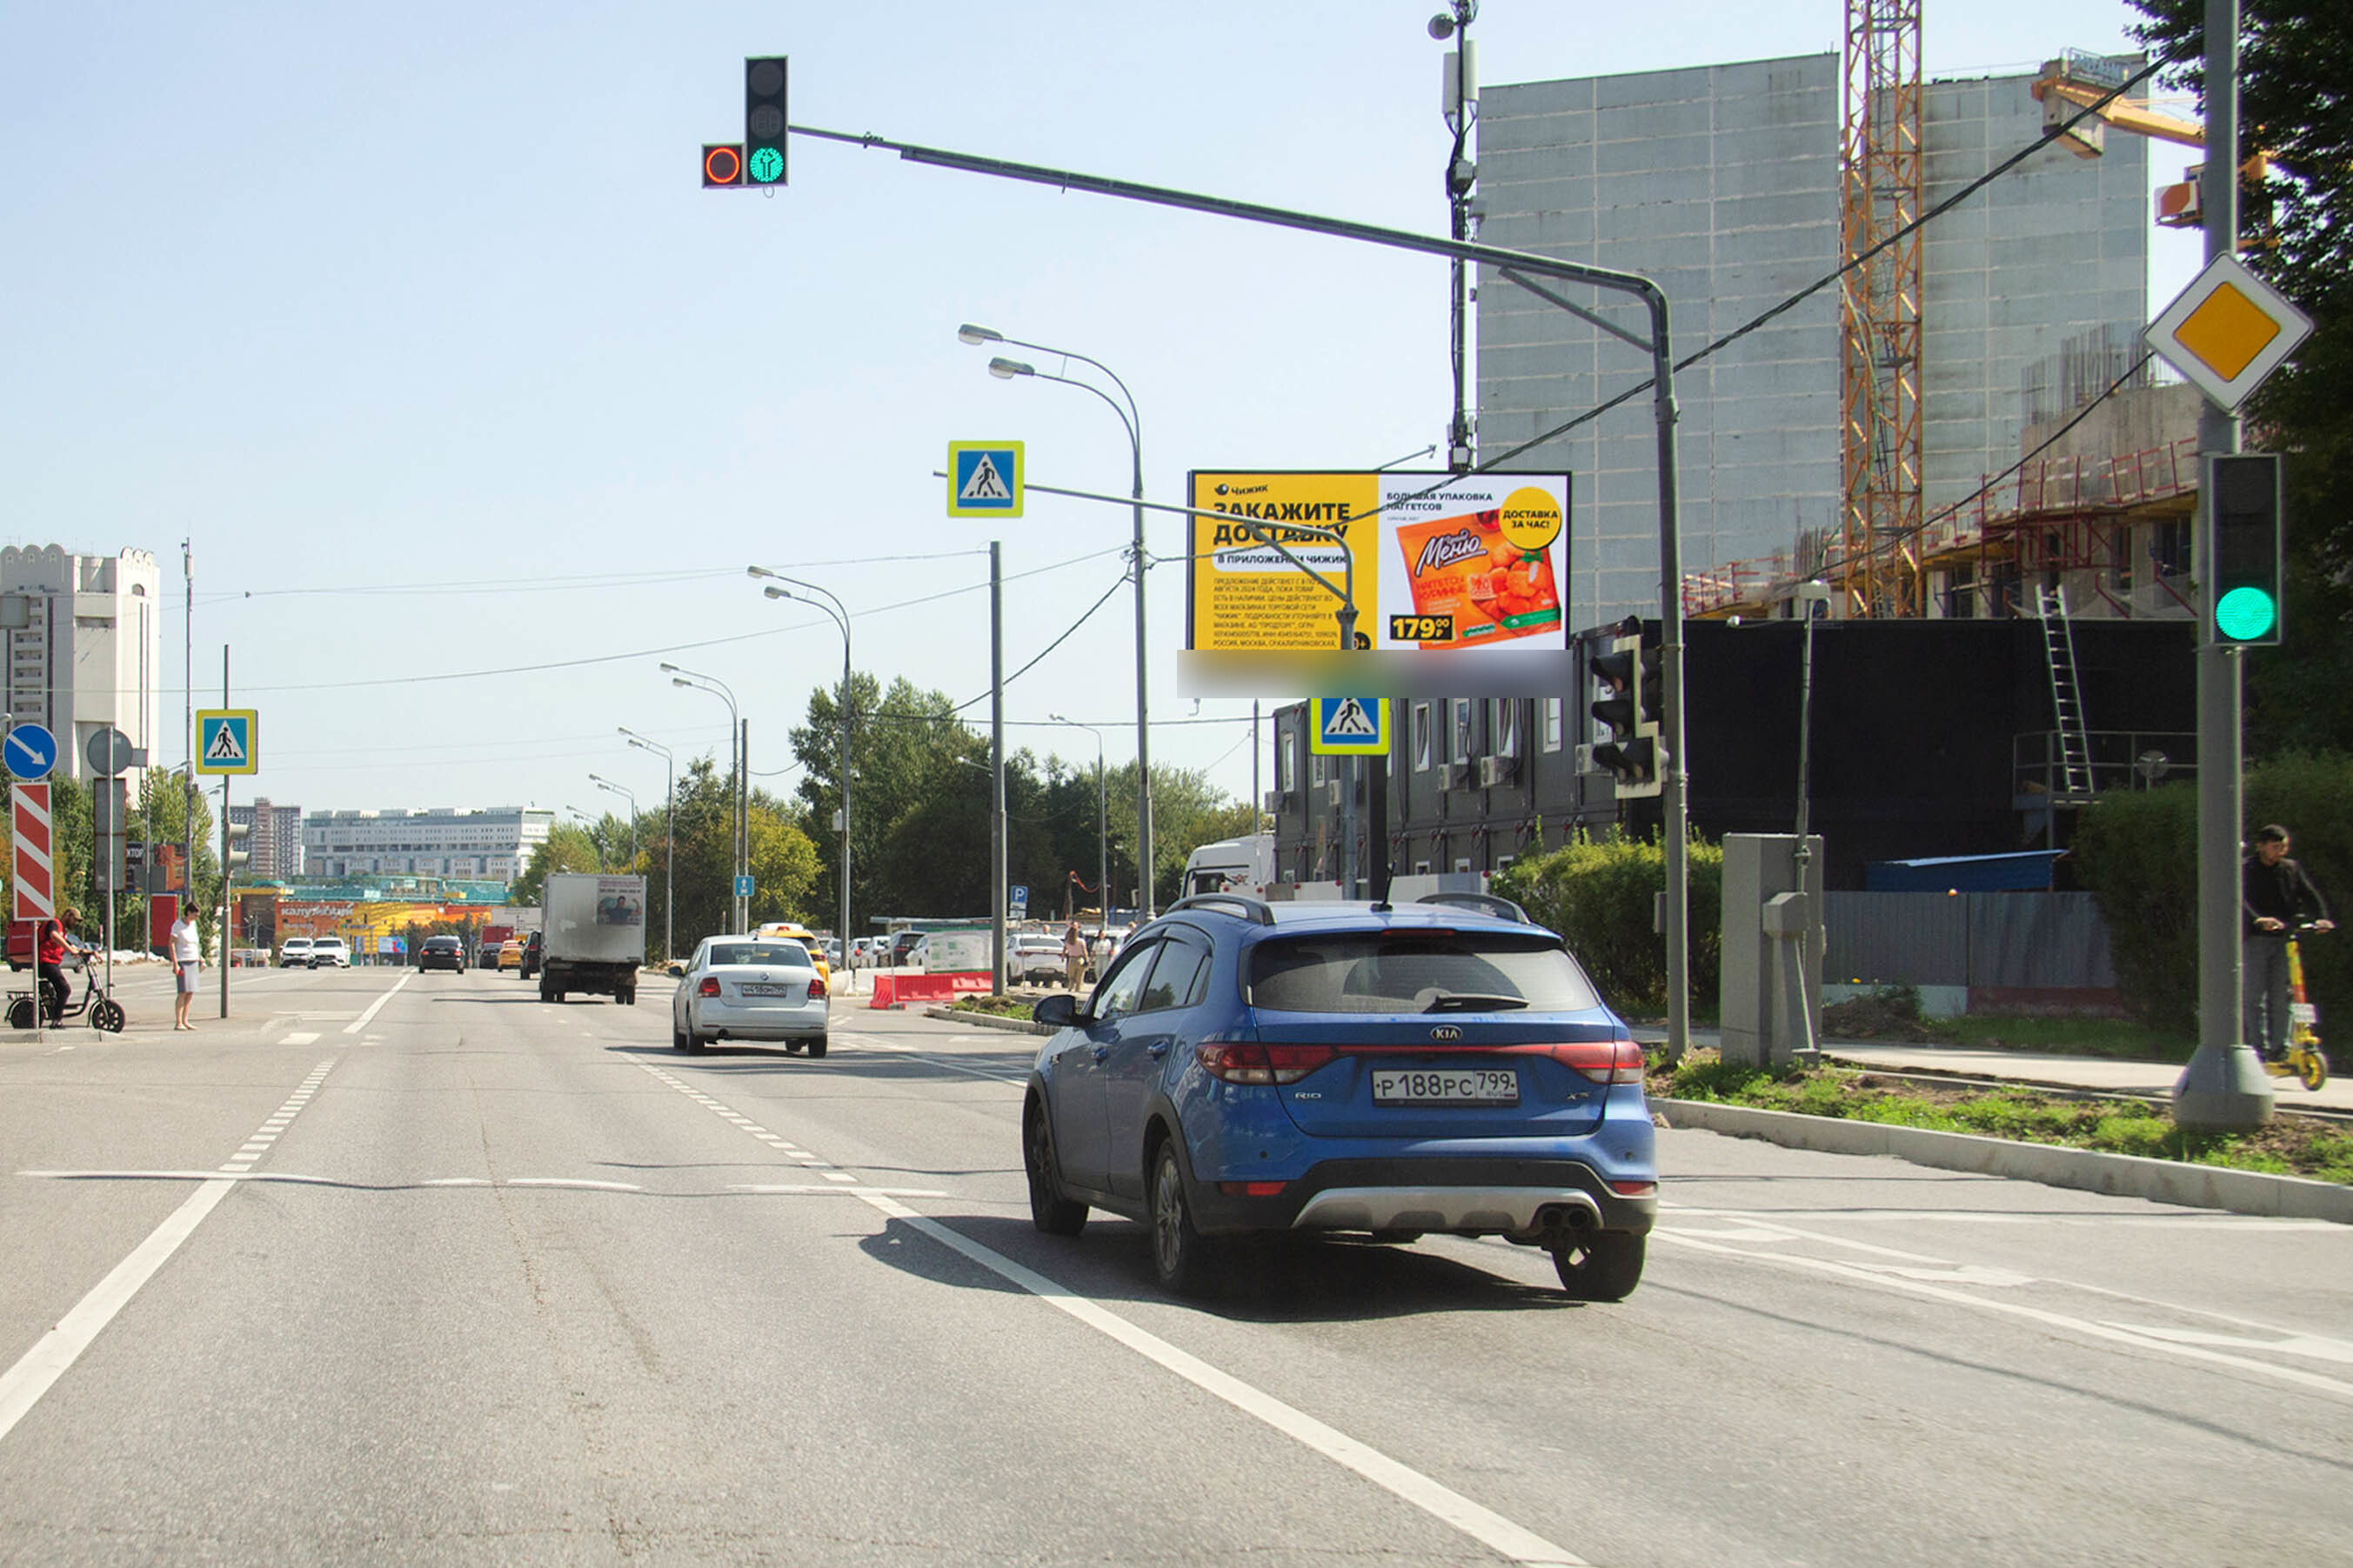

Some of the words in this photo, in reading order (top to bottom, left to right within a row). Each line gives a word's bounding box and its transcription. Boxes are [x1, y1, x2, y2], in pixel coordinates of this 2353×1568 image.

[1439, 493, 1493, 502] УПАКОВКА
[1213, 503, 1350, 521] ЗАКАЖИТЕ
[1502, 510, 1559, 520] ДОСТАВКА
[1511, 520, 1524, 530] ЗА
[1527, 520, 1550, 530] ЧАС!
[1217, 555, 1225, 564] В
[1392, 618, 1435, 637] 179
[1435, 1029, 1458, 1039] KIA
